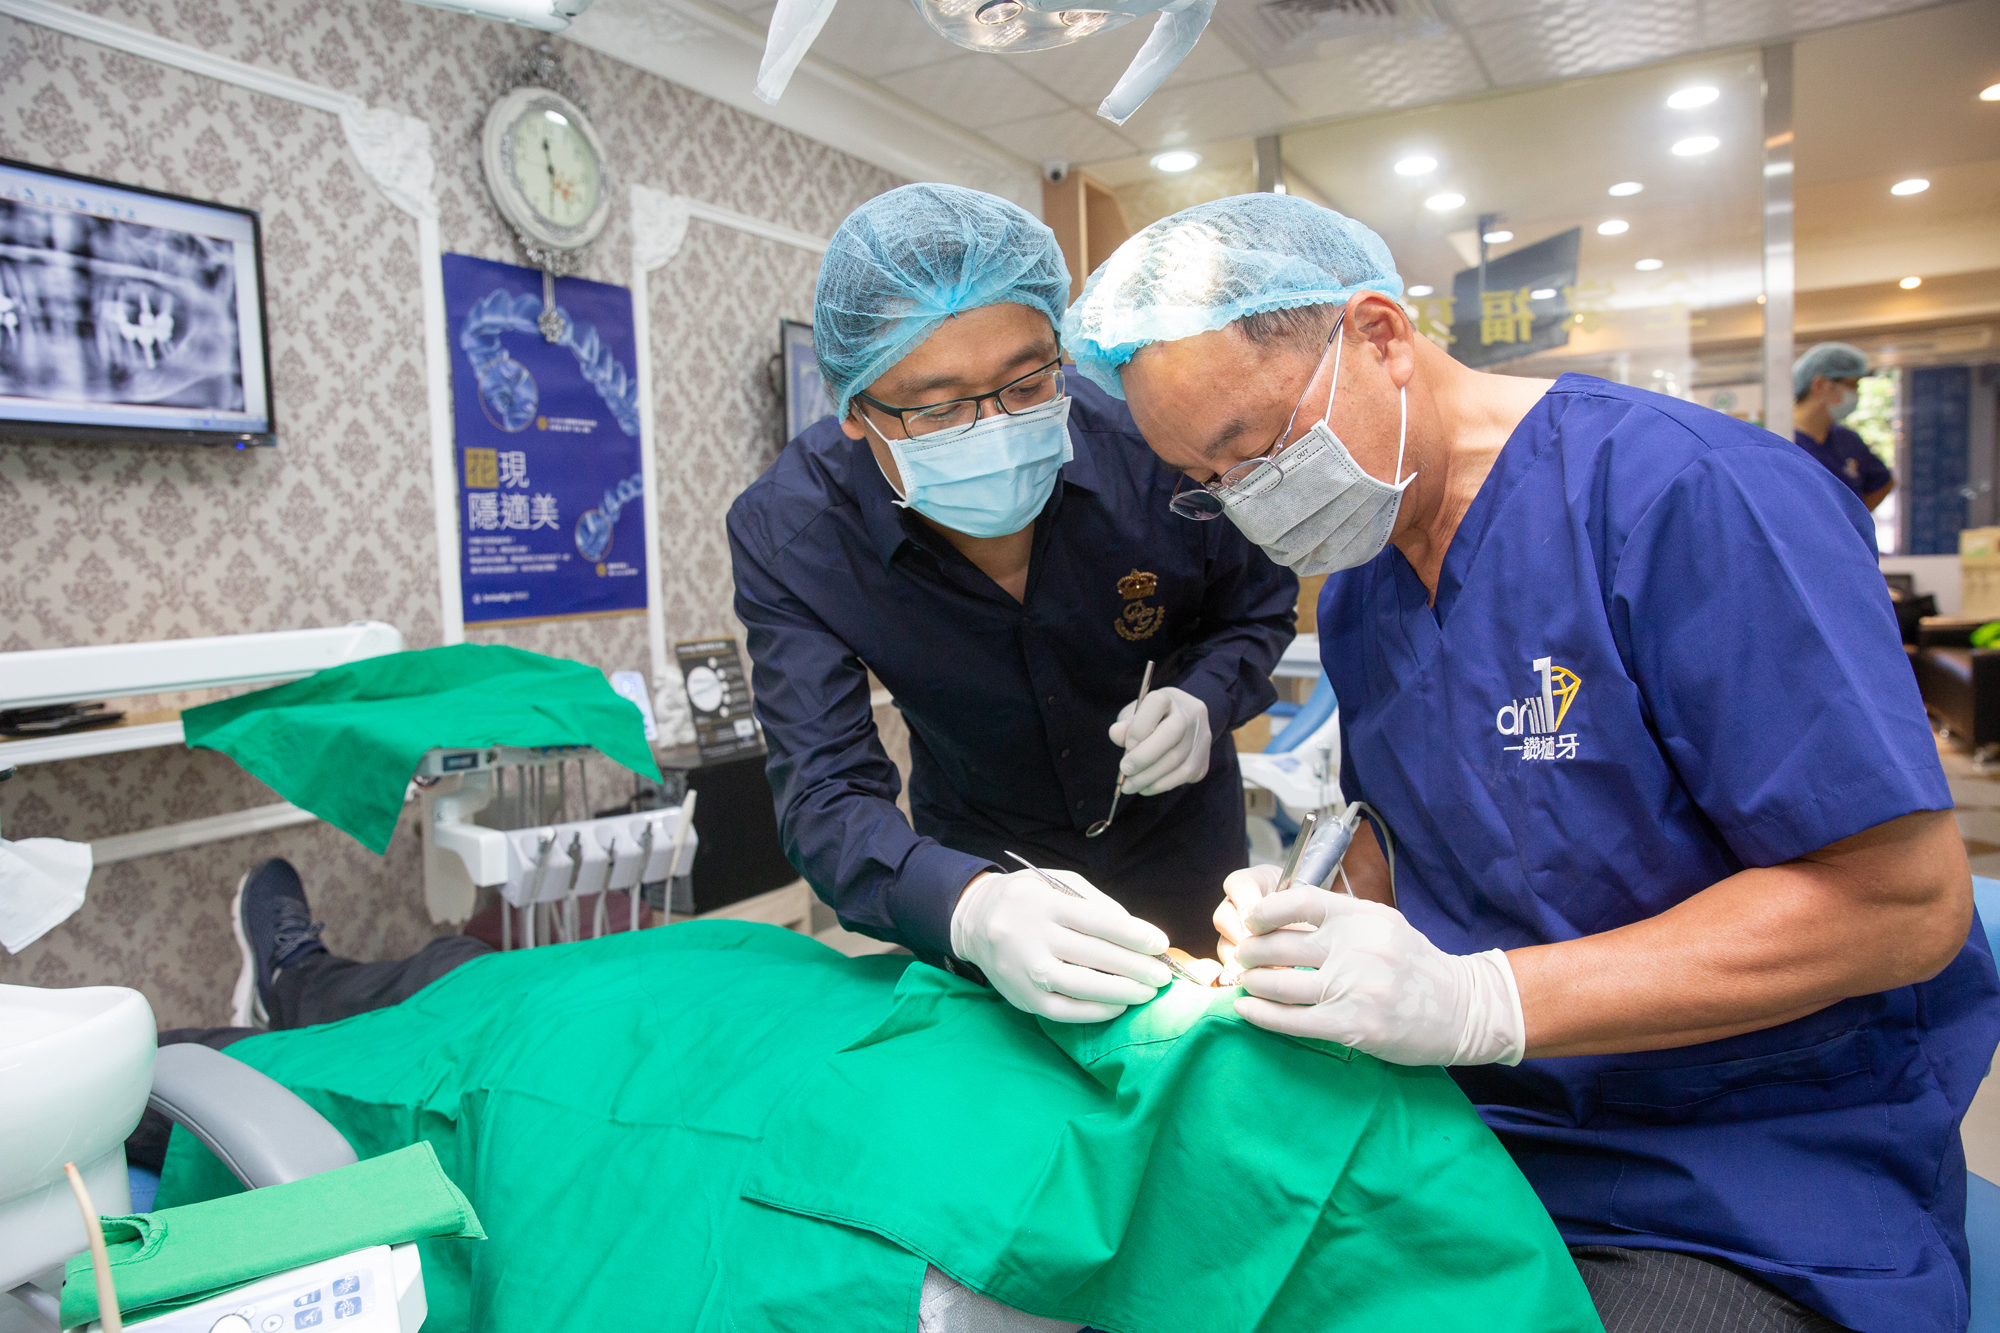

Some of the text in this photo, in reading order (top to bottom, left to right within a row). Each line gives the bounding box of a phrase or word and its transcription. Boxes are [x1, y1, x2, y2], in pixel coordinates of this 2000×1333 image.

[1297, 448, 1309, 459] OUT
[468, 491, 560, 531] 隱適美
